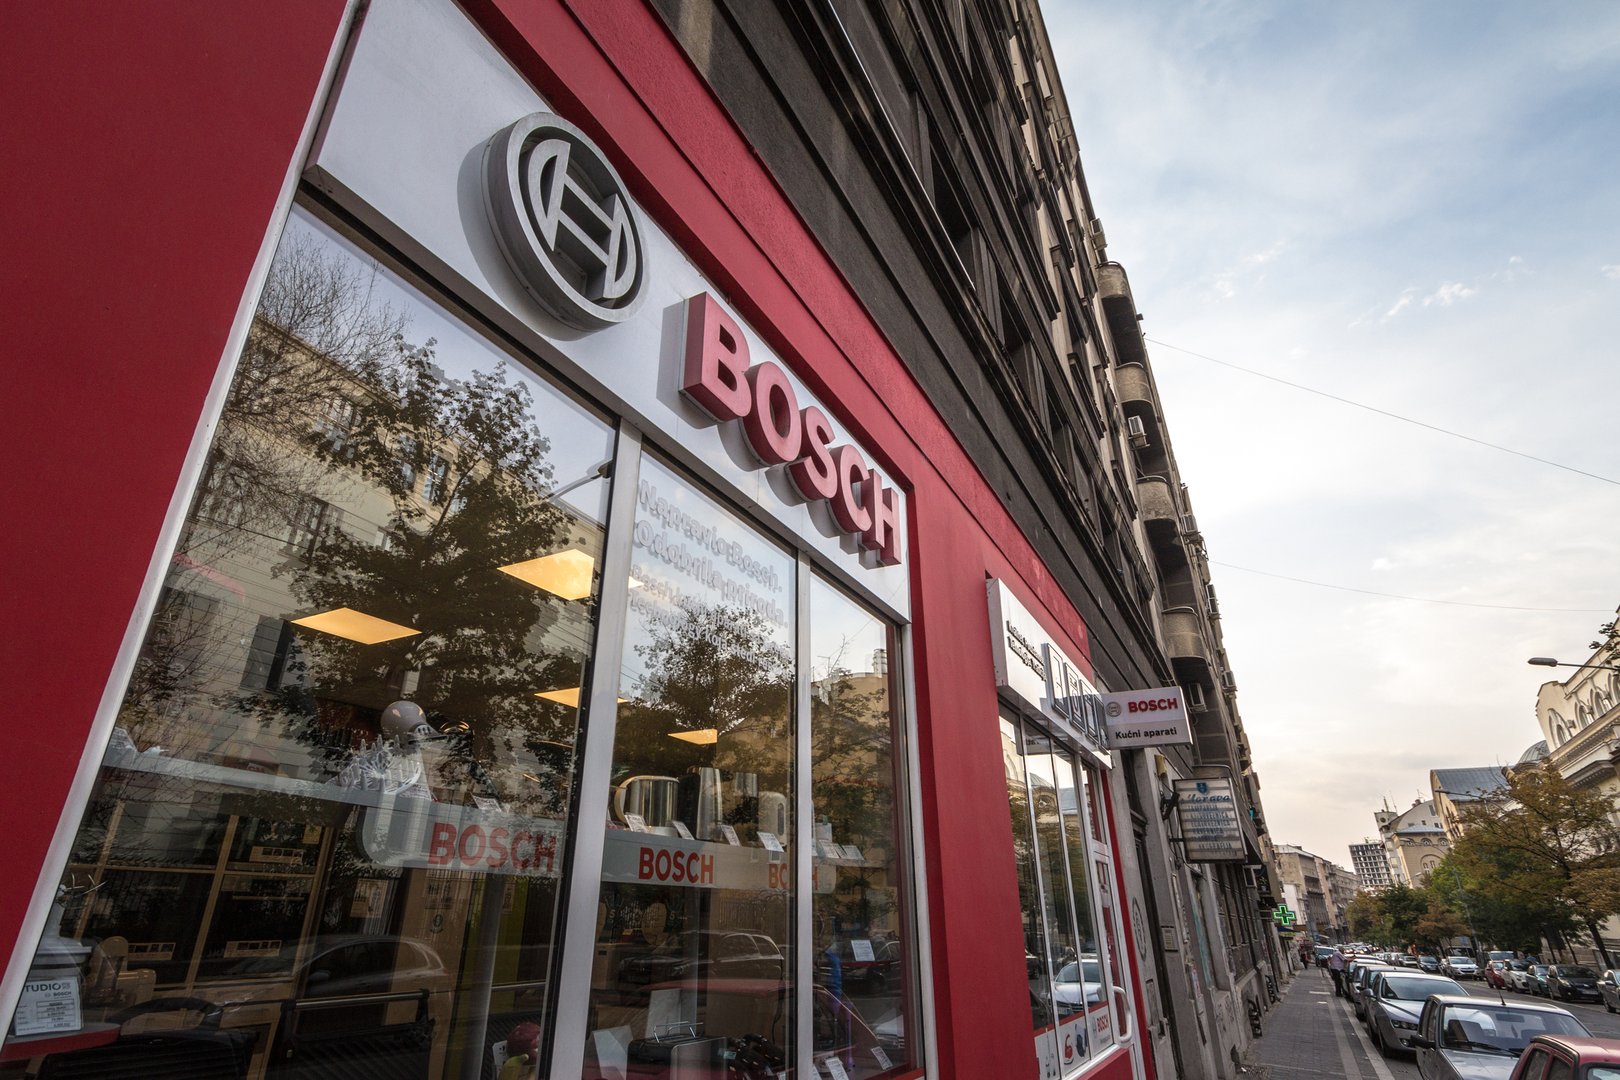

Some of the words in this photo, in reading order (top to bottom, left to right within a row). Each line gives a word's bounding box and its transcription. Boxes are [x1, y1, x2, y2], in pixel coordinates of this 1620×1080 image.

[678, 291, 902, 566] BOSCH
[1128, 698, 1178, 713] BOSCH
[1115, 728, 1141, 740] Kućni
[1143, 727, 1177, 739] aparati
[427, 822, 556, 872] BOSCH
[638, 847, 714, 883] BOSCH
[25, 982, 61, 993] TUDIO
